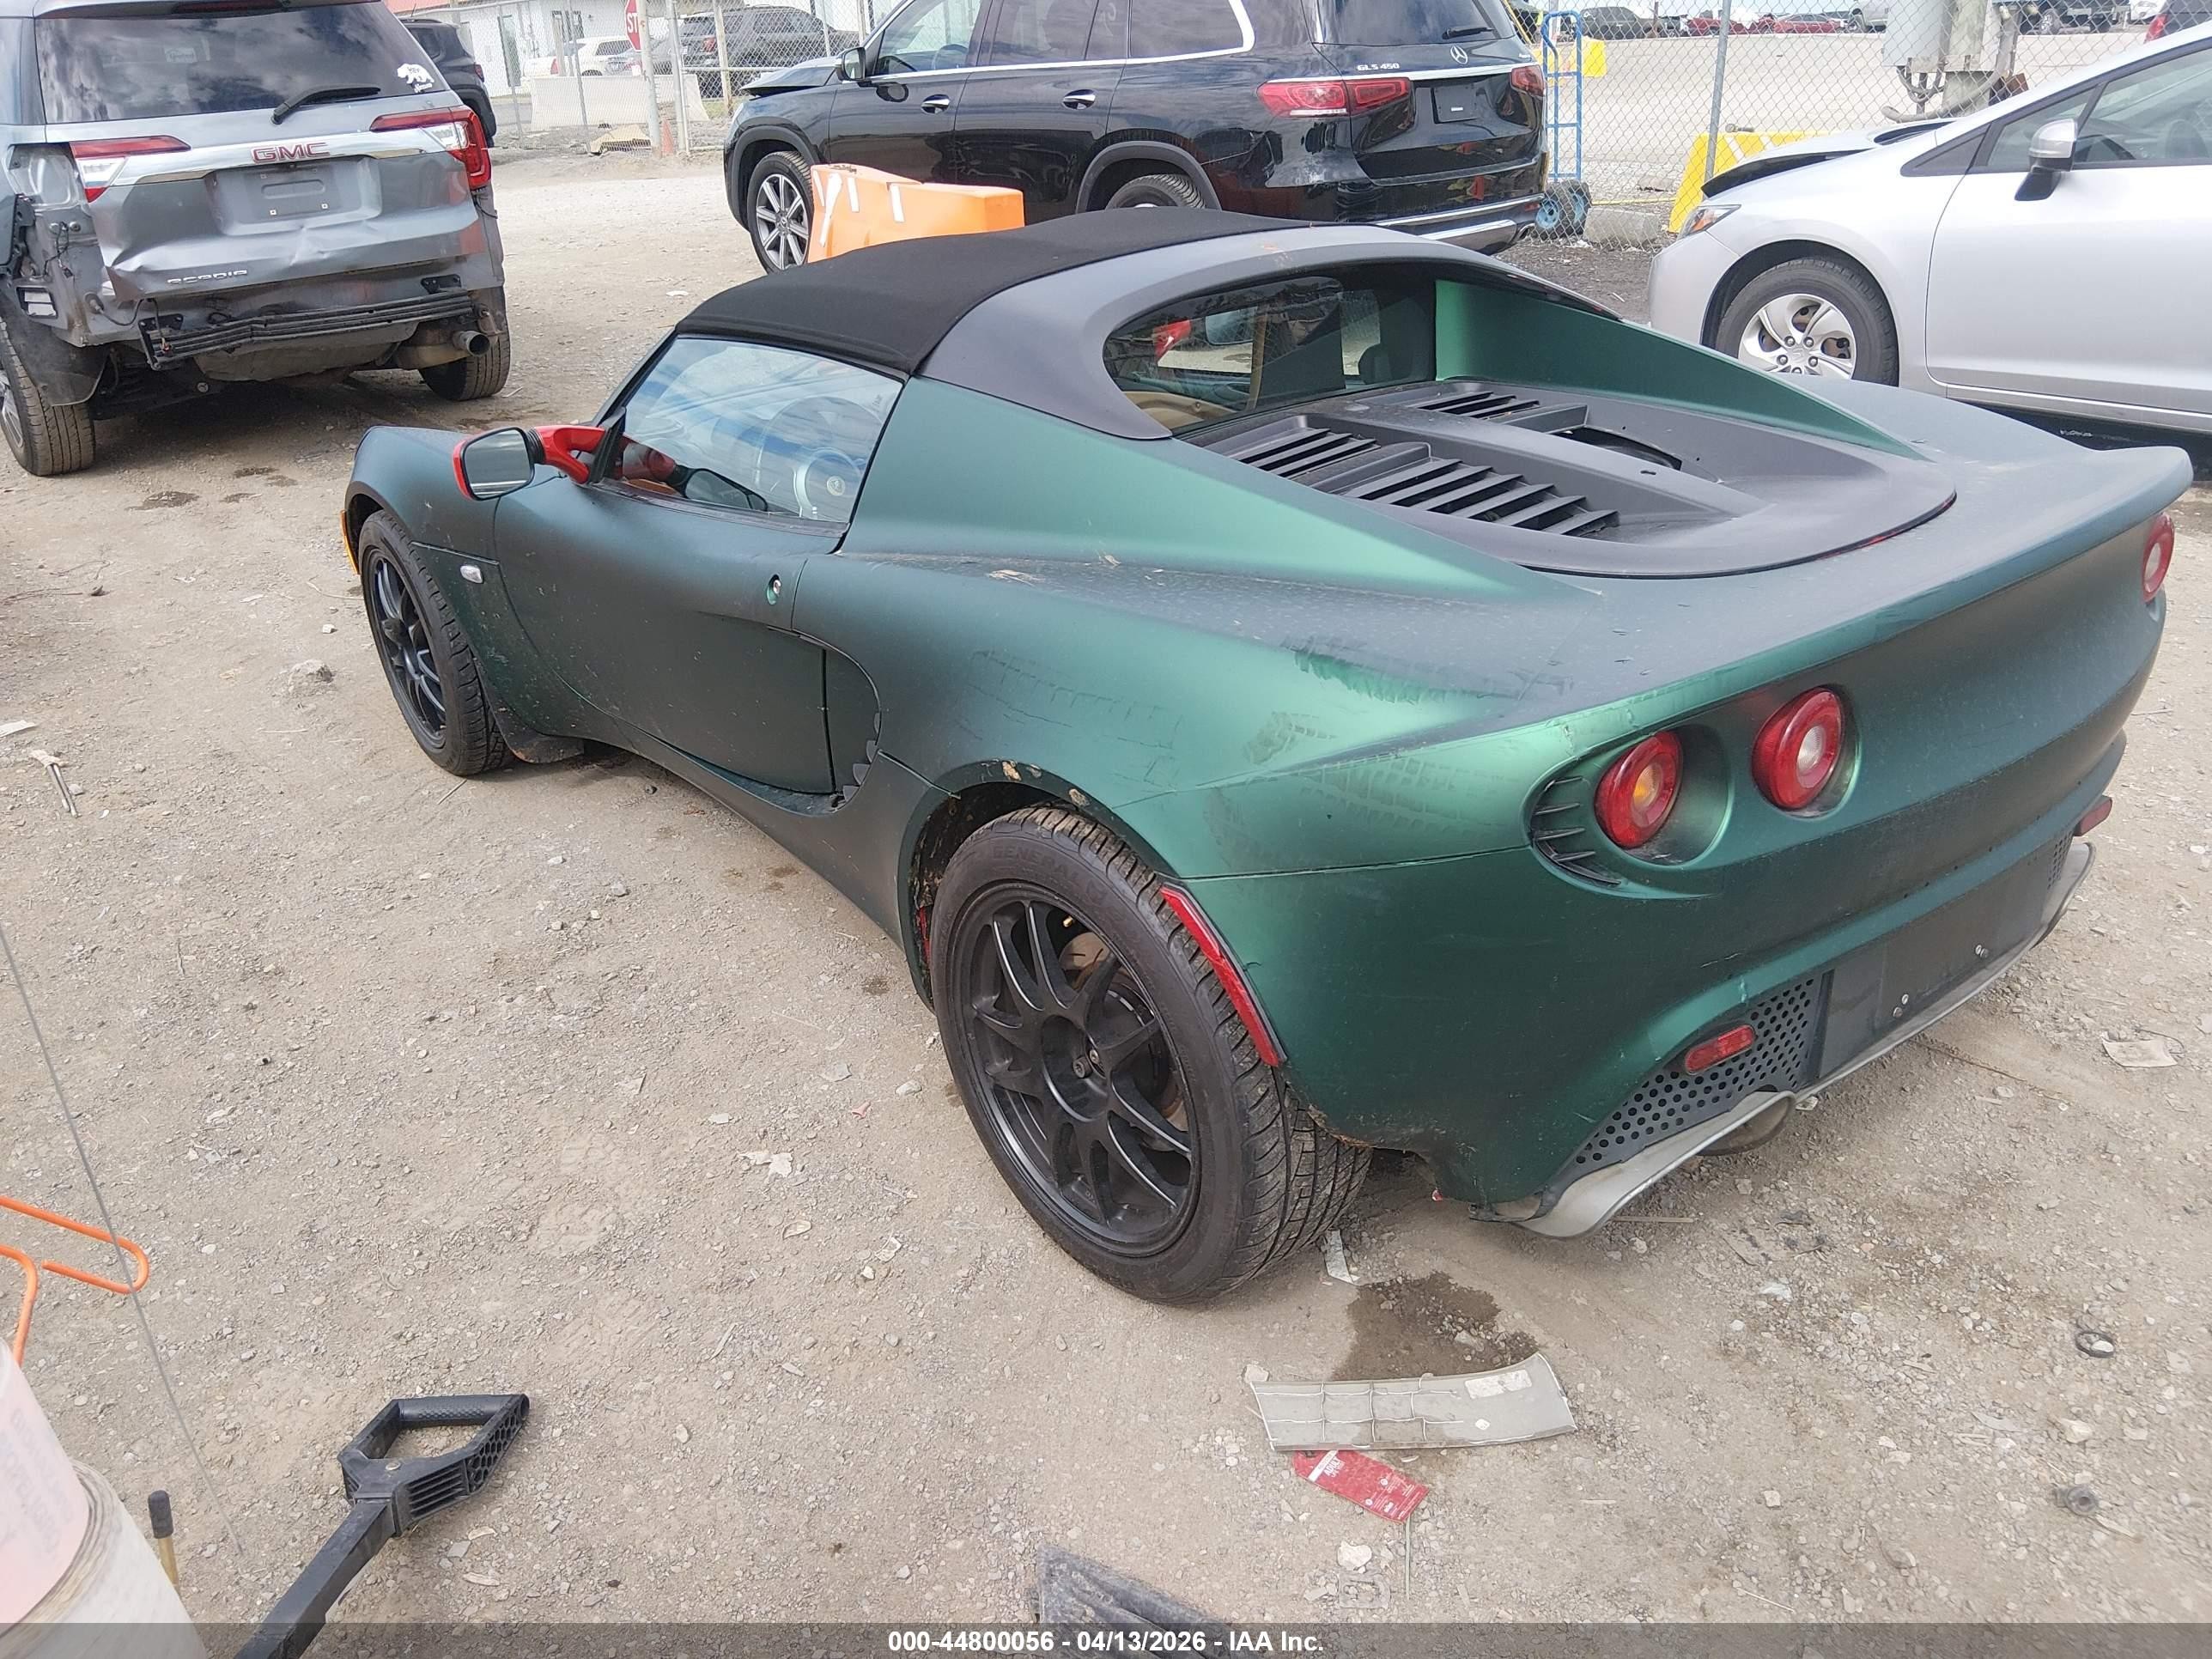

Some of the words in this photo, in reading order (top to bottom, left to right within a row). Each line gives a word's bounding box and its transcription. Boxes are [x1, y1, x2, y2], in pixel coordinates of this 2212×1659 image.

[627, 12, 638, 33] ST
[251, 142, 330, 164] GMC
[167, 270, 247, 283] ACADIA
